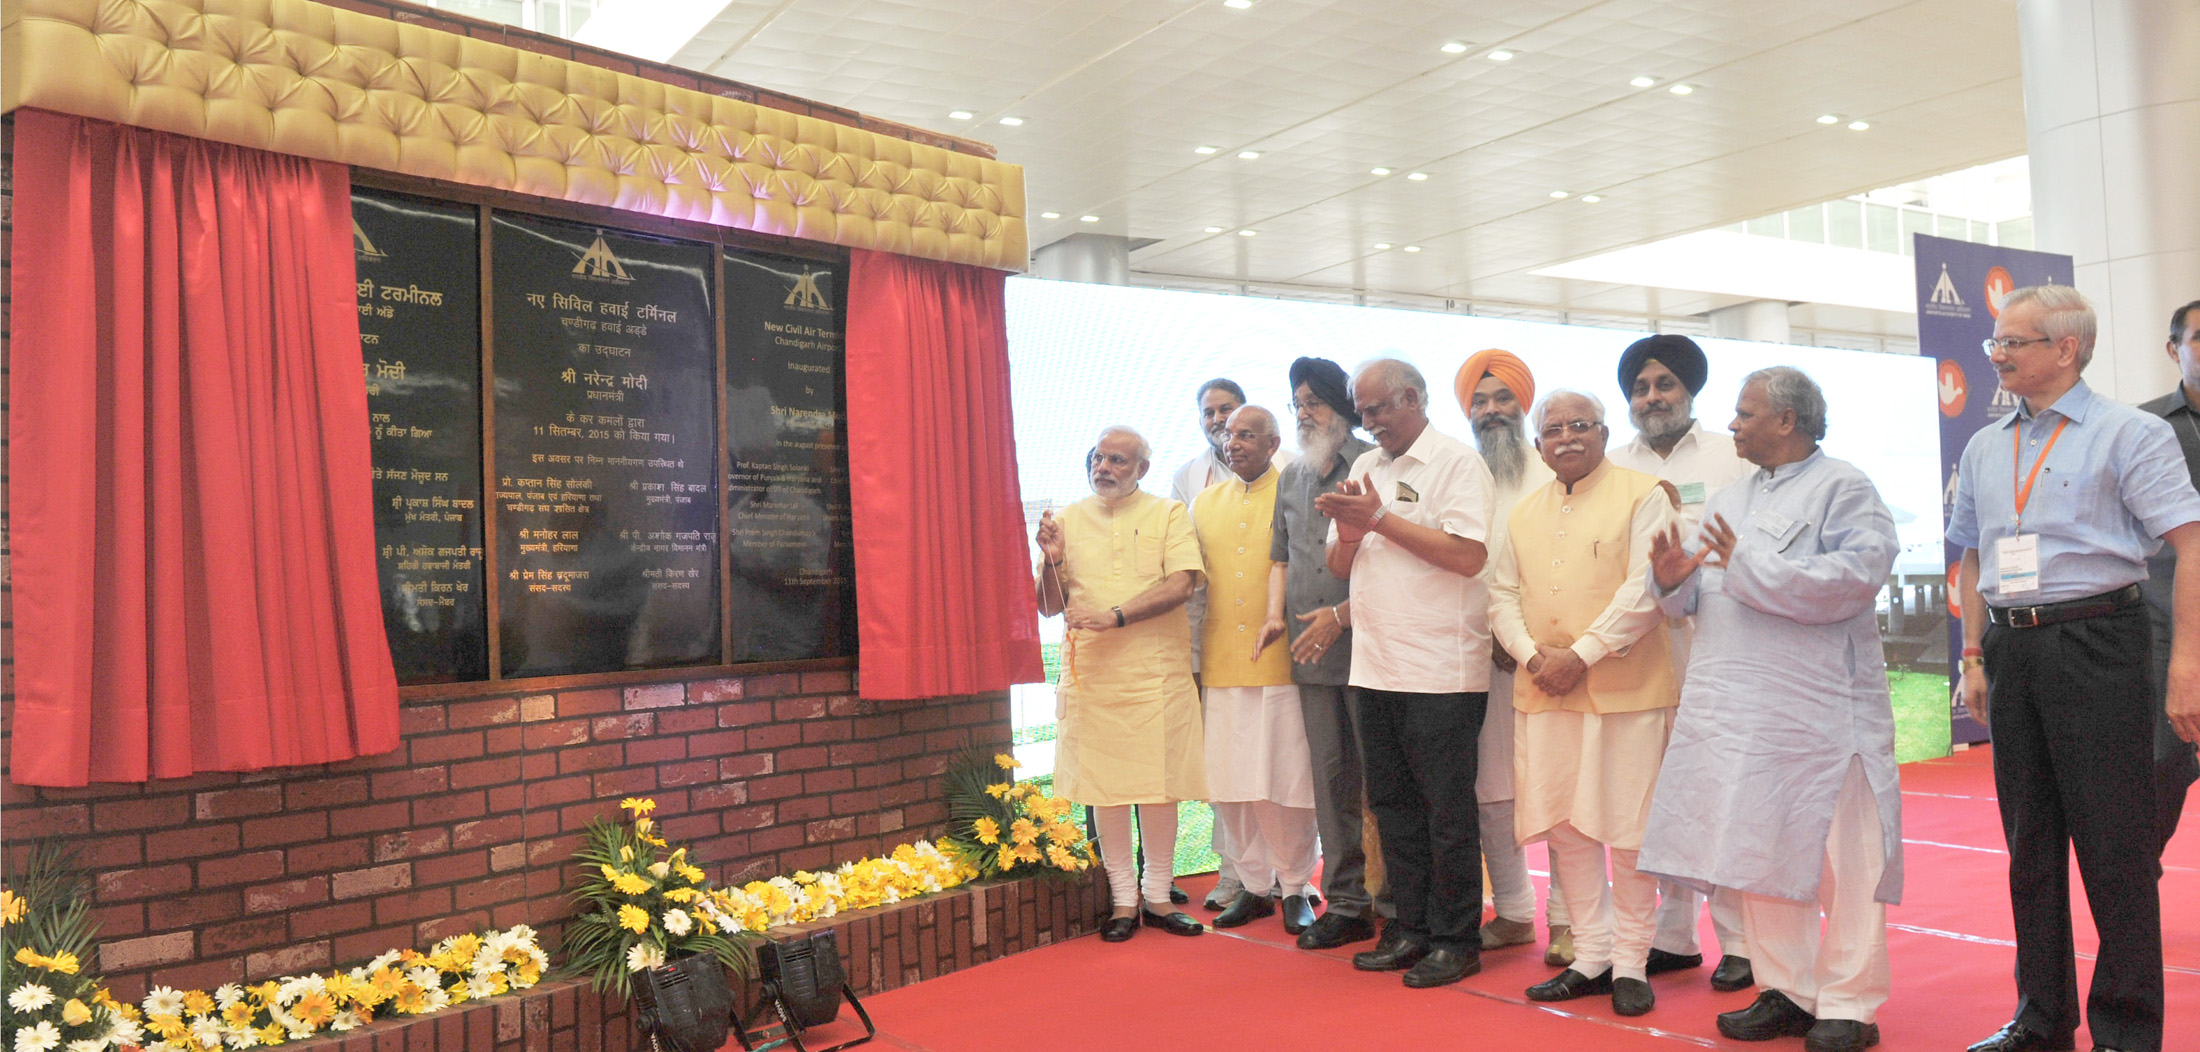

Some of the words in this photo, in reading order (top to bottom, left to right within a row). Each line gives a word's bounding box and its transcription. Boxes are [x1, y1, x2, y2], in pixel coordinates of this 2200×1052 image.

[381, 284, 444, 306] ਟਰਮੀਨਲ
[526, 293, 545, 309] नए
[552, 293, 593, 313] सिविल
[600, 301, 630, 319] हवाई
[637, 303, 678, 323] टर्मिनल
[601, 320, 622, 335] हवाई
[764, 321, 784, 332] New
[785, 324, 803, 335] Civil
[804, 326, 816, 337] Air
[578, 343, 591, 353] का
[775, 336, 816, 350] Chandigarh
[376, 358, 406, 380] ਮੋਦੀ
[787, 361, 831, 374] Inaugurated
[561, 368, 576, 384] श्री
[583, 369, 615, 387] नरेन्द्र
[621, 372, 648, 390] मोदी
[587, 389, 624, 402] प्रधानमंत्री
[805, 385, 815, 396] by
[770, 405, 787, 416] Shri
[372, 413, 391, 423] ਨਾਲ
[565, 411, 575, 422] के
[579, 414, 594, 425] कर
[628, 418, 645, 428] द्वारा
[386, 425, 407, 437] ਕੀਤਾ
[410, 425, 433, 438] ਗਿਆ
[533, 426, 544, 436] 11
[588, 429, 610, 440] 2015
[614, 428, 625, 440] को
[629, 429, 650, 442] किया
[531, 453, 545, 464] इस
[548, 454, 571, 464] अवसर
[574, 455, 584, 465] पर
[546, 476, 562, 488] सिंह
[519, 528, 529, 540] श्री
[533, 528, 558, 540] मनोहर
[562, 531, 579, 540] लाल
